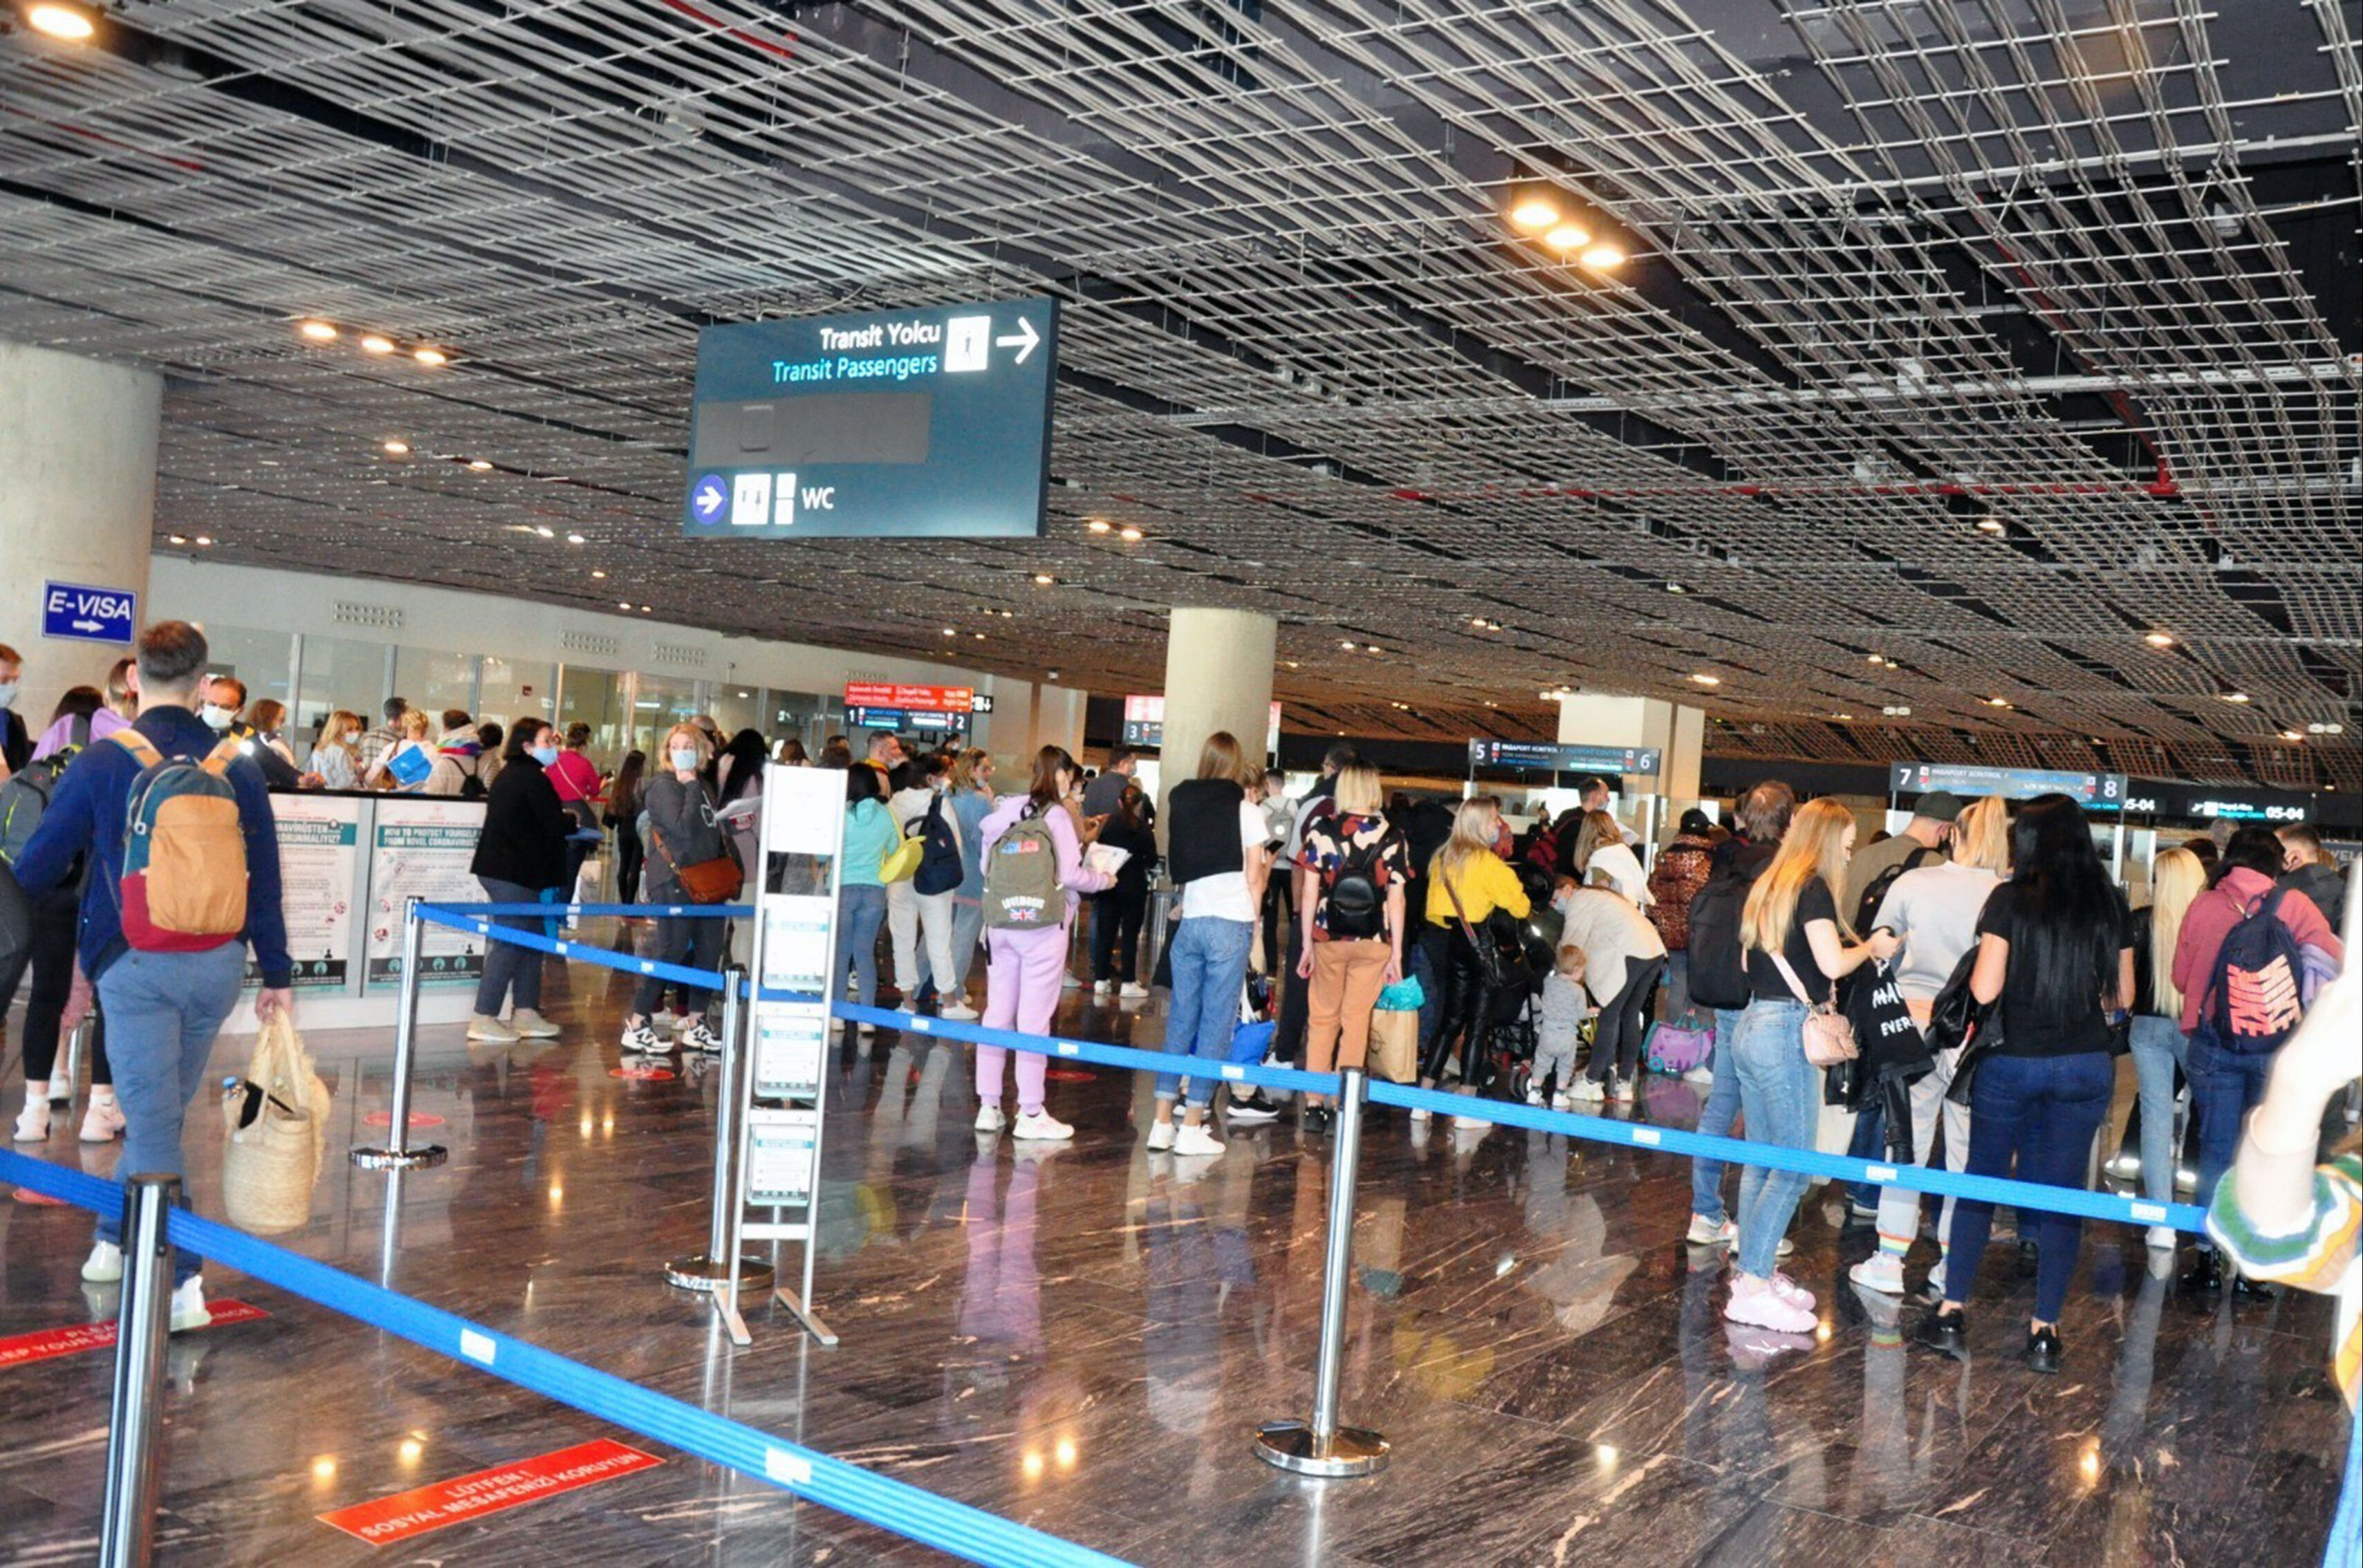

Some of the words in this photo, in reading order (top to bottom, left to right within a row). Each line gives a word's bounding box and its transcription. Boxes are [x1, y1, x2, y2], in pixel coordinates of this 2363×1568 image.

[820, 325, 882, 351] Transit
[888, 320, 940, 345] Yolcu
[772, 357, 832, 383] Transit
[836, 354, 937, 381] Passengers
[802, 487, 835, 510] WC
[48, 590, 131, 621] E-VISA
[849, 709, 855, 722] 1
[956, 716, 965, 729] 2
[1129, 725, 1138, 739] 3
[1475, 744, 1485, 759] 5
[1640, 754, 1650, 769] 6
[1900, 769, 1911, 785] 7
[2104, 781, 2118, 798] 8
[553, 1453, 643, 1482] KORUYUN
